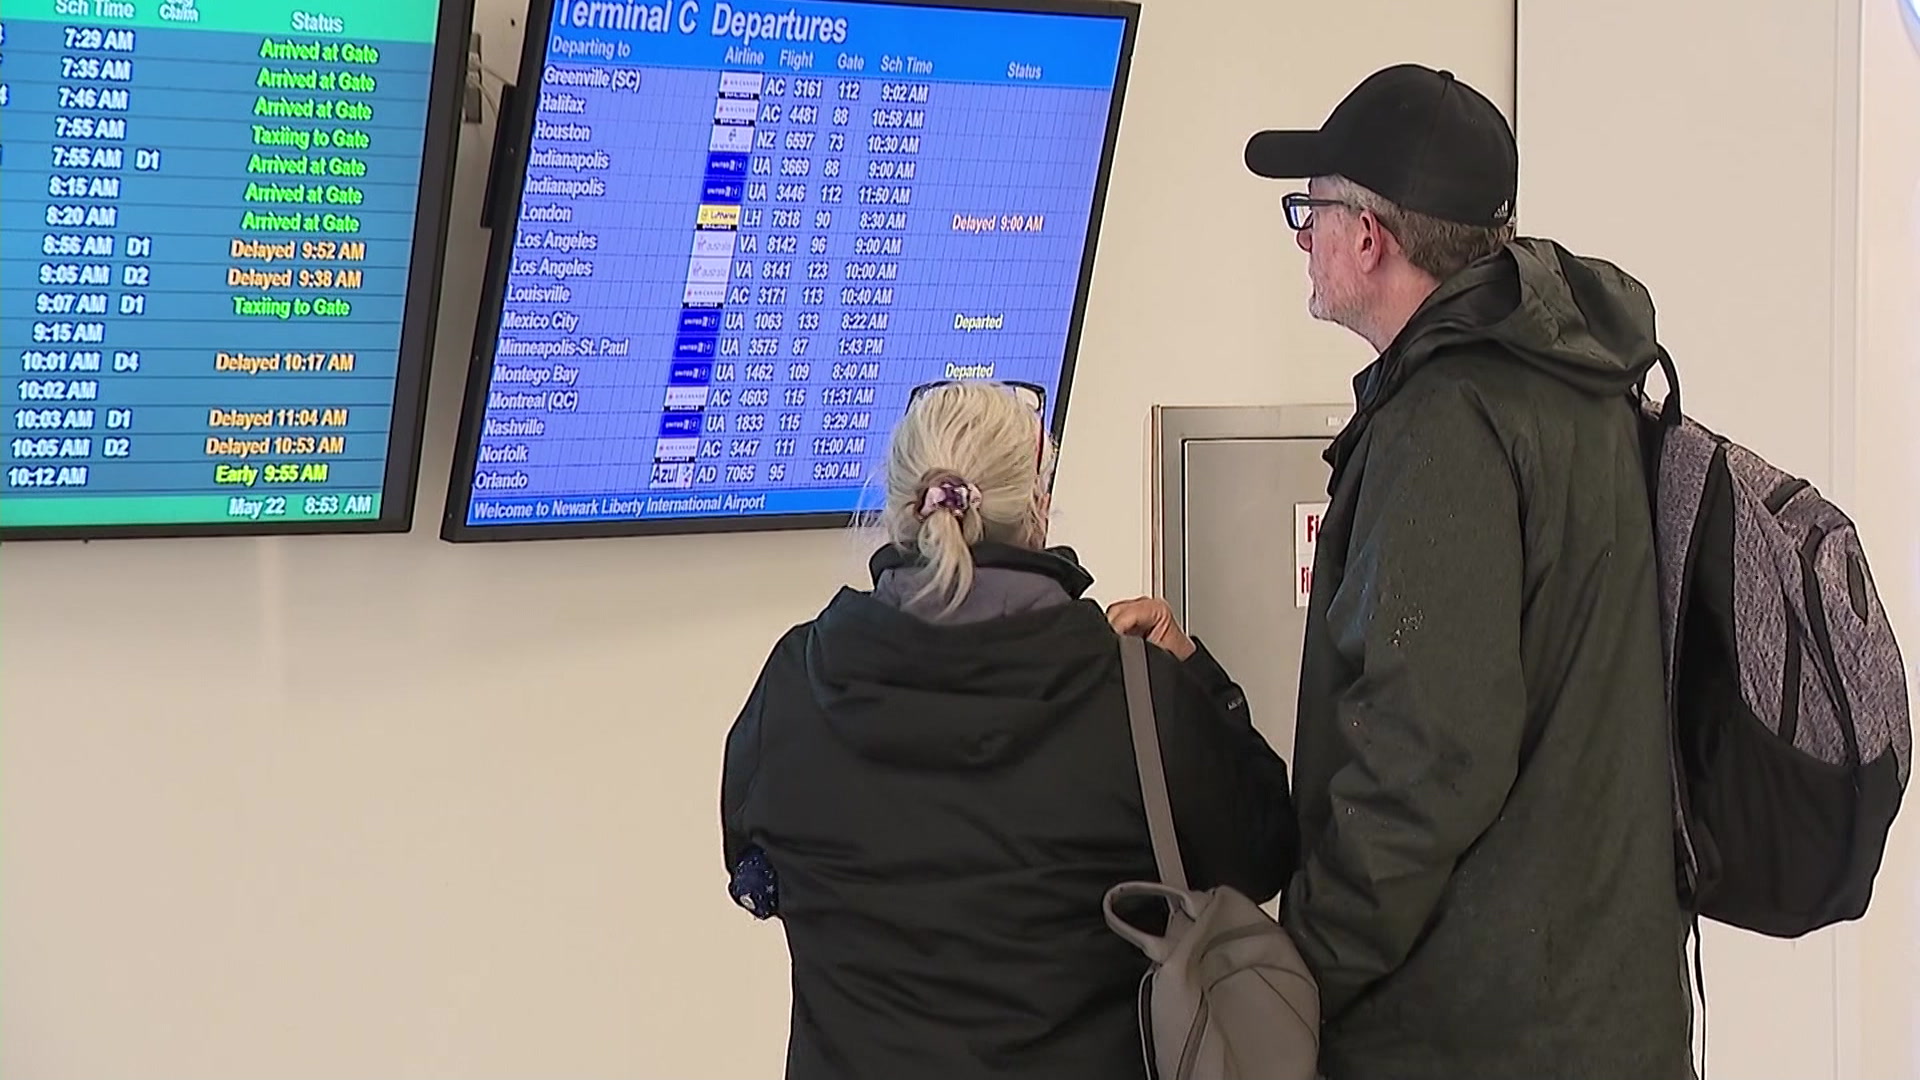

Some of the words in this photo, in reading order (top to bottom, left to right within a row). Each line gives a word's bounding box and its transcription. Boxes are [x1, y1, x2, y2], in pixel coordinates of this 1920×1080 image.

[56, 0, 88, 16] Sch
[92, 0, 134, 18] Time
[292, 12, 343, 33] Status
[558, 0, 670, 32] Terminal
[679, 0, 698, 34] C
[712, 3, 846, 45] Departures
[64, 28, 100, 50] 7:29
[104, 31, 134, 52] AM
[261, 39, 319, 61] Arrived
[323, 42, 338, 61] at
[343, 43, 379, 64] Gate
[552, 37, 615, 58] Departing
[618, 42, 631, 57] to
[725, 46, 764, 65] Airline
[61, 57, 98, 80] 7:35
[101, 60, 131, 81] AM
[779, 49, 813, 70] Flight
[838, 55, 864, 70] Gate
[881, 55, 903, 73] Sch
[906, 58, 932, 75] Time
[1007, 62, 1042, 79] Status
[544, 69, 610, 87] Greenville
[612, 70, 640, 92] (SC)
[765, 77, 785, 96] AC
[794, 80, 822, 97] 3161
[838, 82, 860, 100] 112
[881, 84, 907, 101] 9:02
[58, 87, 96, 108] 7:46
[99, 89, 128, 110] AM
[539, 95, 585, 114] Halifax
[790, 106, 818, 124] 4481
[833, 108, 848, 125] 88
[252, 126, 310, 149] Taxiing
[313, 128, 328, 147] to
[332, 129, 370, 149] Gate
[535, 122, 591, 141] Houston
[758, 132, 776, 148] NZ
[785, 133, 814, 150] 6597
[829, 134, 844, 150] 73
[868, 135, 898, 152] 10:30
[530, 148, 609, 172] Indianapolis
[824, 159, 839, 177] 88
[869, 161, 894, 178] 9:00
[525, 176, 605, 198] Indianapolis
[821, 186, 841, 202] 112
[46, 206, 83, 227] 8:20
[86, 207, 116, 228] AM
[242, 211, 300, 232] Arrived
[304, 216, 320, 232] at
[324, 215, 360, 232] Gate
[521, 204, 571, 222] London
[743, 211, 762, 227] LH
[772, 211, 800, 228] 7818
[815, 212, 831, 228] 90
[860, 212, 884, 229] 8:30
[952, 214, 995, 233] Delayed
[1000, 215, 1024, 231] 9:00
[1025, 216, 1043, 231] AM
[231, 240, 294, 262] Delayed
[302, 242, 336, 260] 9:52
[516, 229, 540, 246] Los
[545, 230, 597, 251] Angeles
[740, 236, 757, 252] VA
[767, 236, 796, 253] 8142
[811, 237, 826, 253] 96
[856, 238, 881, 254] 9:00
[40, 264, 77, 283] 9:05
[80, 264, 110, 285] AM
[123, 266, 149, 286] D2
[228, 269, 291, 292] Delayed
[299, 270, 333, 288] 9:38
[735, 262, 752, 278] VA
[763, 262, 791, 279] 8141
[807, 263, 828, 279] 123
[845, 263, 875, 279] 10:00
[507, 284, 570, 302] Louisville
[730, 287, 749, 304] AC
[758, 287, 786, 304] 3171
[803, 288, 824, 304] 113
[841, 288, 871, 305] 10:40
[36, 294, 74, 312] 9:07
[77, 294, 106, 313] AM
[119, 295, 144, 314] D1
[234, 296, 290, 319] Taxiing
[294, 299, 309, 316] to
[313, 298, 350, 317] Gate
[502, 312, 551, 329] Mexico
[553, 312, 579, 331] City
[798, 314, 818, 330] 133
[842, 314, 866, 330] 8:22
[954, 314, 1003, 332] Departed
[498, 338, 596, 359] Minneapolis-St.
[600, 339, 628, 355] Paul
[721, 340, 739, 355] UA
[750, 339, 777, 355] 3575
[793, 339, 808, 355] 87
[839, 339, 863, 355] 1:43
[21, 352, 68, 371] 10:01
[70, 352, 100, 371] AM
[114, 352, 139, 371] D4
[216, 353, 279, 374] Delayed
[283, 354, 325, 371] 10:17
[493, 366, 550, 385] Montego
[553, 366, 578, 385] Bay
[716, 366, 734, 381] UA
[746, 365, 773, 381] 1462
[789, 364, 809, 380] 109
[833, 363, 857, 379] 8:40
[945, 362, 994, 380] Departed
[489, 392, 545, 408] Montreal
[548, 392, 577, 411] (QC)
[784, 390, 805, 406] 115
[822, 390, 851, 406] 11:31
[15, 409, 61, 428] 10:03
[63, 409, 93, 428] AM
[106, 410, 131, 428] D1
[208, 409, 272, 431] Delayed
[277, 410, 319, 427] 11:04
[484, 419, 544, 436] Nashville
[707, 416, 725, 432] UA
[736, 415, 763, 431] 1833
[780, 415, 800, 432] 115
[823, 414, 848, 430] 9:29
[206, 437, 269, 459] Delayed
[274, 438, 315, 455] 10:53
[480, 445, 528, 462] Norfolk
[702, 442, 721, 457] AC
[731, 441, 758, 457] 3447
[775, 440, 794, 456] 111
[813, 439, 843, 455] 11:00
[215, 464, 258, 487] Early
[264, 464, 298, 482] 9:55
[476, 472, 528, 489] Orlando
[651, 465, 678, 484] Azul
[697, 467, 716, 482] AD
[769, 464, 785, 480] 95
[814, 464, 839, 479] 9:00
[229, 497, 261, 519] May
[266, 498, 285, 515] 22
[304, 496, 339, 514] 8:53
[344, 495, 371, 513] AM
[474, 502, 533, 518] Welcome
[536, 501, 548, 517] to
[552, 500, 598, 516] Newark
[601, 499, 643, 516] Liberty
[647, 496, 721, 513] International
[723, 494, 766, 512] Airport
